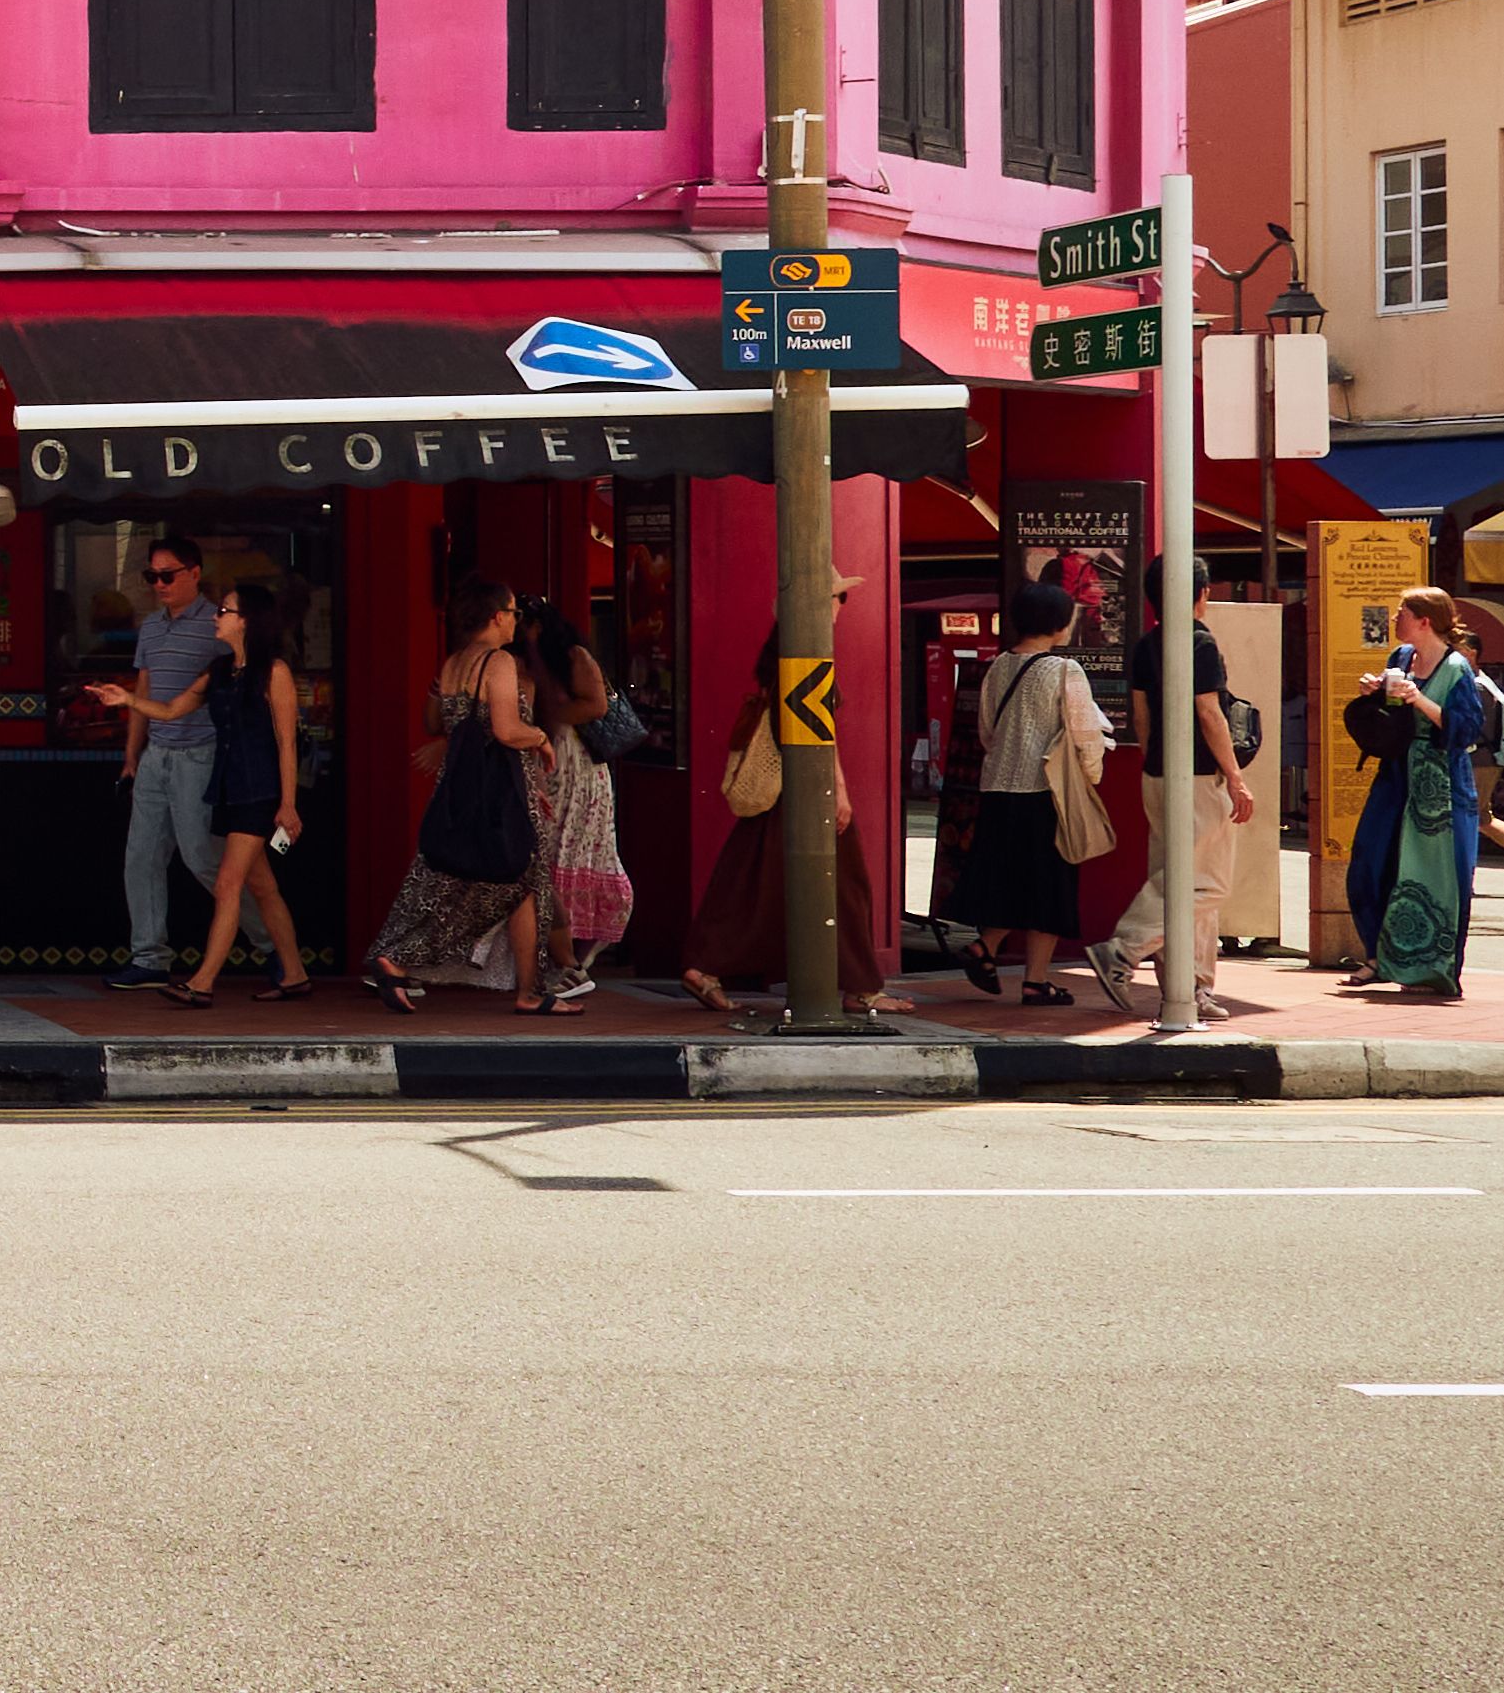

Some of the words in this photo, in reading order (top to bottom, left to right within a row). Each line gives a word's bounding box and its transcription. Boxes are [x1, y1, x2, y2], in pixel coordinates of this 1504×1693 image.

[1050, 225, 1121, 279] Smith
[1132, 218, 1158, 264] St
[823, 267, 846, 276] MRT
[792, 316, 805, 325] TE
[808, 316, 821, 325] 18
[732, 328, 768, 341] 100m
[786, 335, 852, 350] Maxwell
[1043, 319, 1157, 370] 史密斯街
[30, 437, 199, 482] OLD
[279, 426, 638, 474] COFFEE
[1017, 512, 1044, 520] THE
[1054, 512, 1101, 520] CRAFT
[1112, 512, 1129, 520] OF
[1017, 527, 1086, 536] TRADITIONAL
[1089, 527, 1129, 536] COFFEE
[1083, 663, 1124, 671] COFFEE
